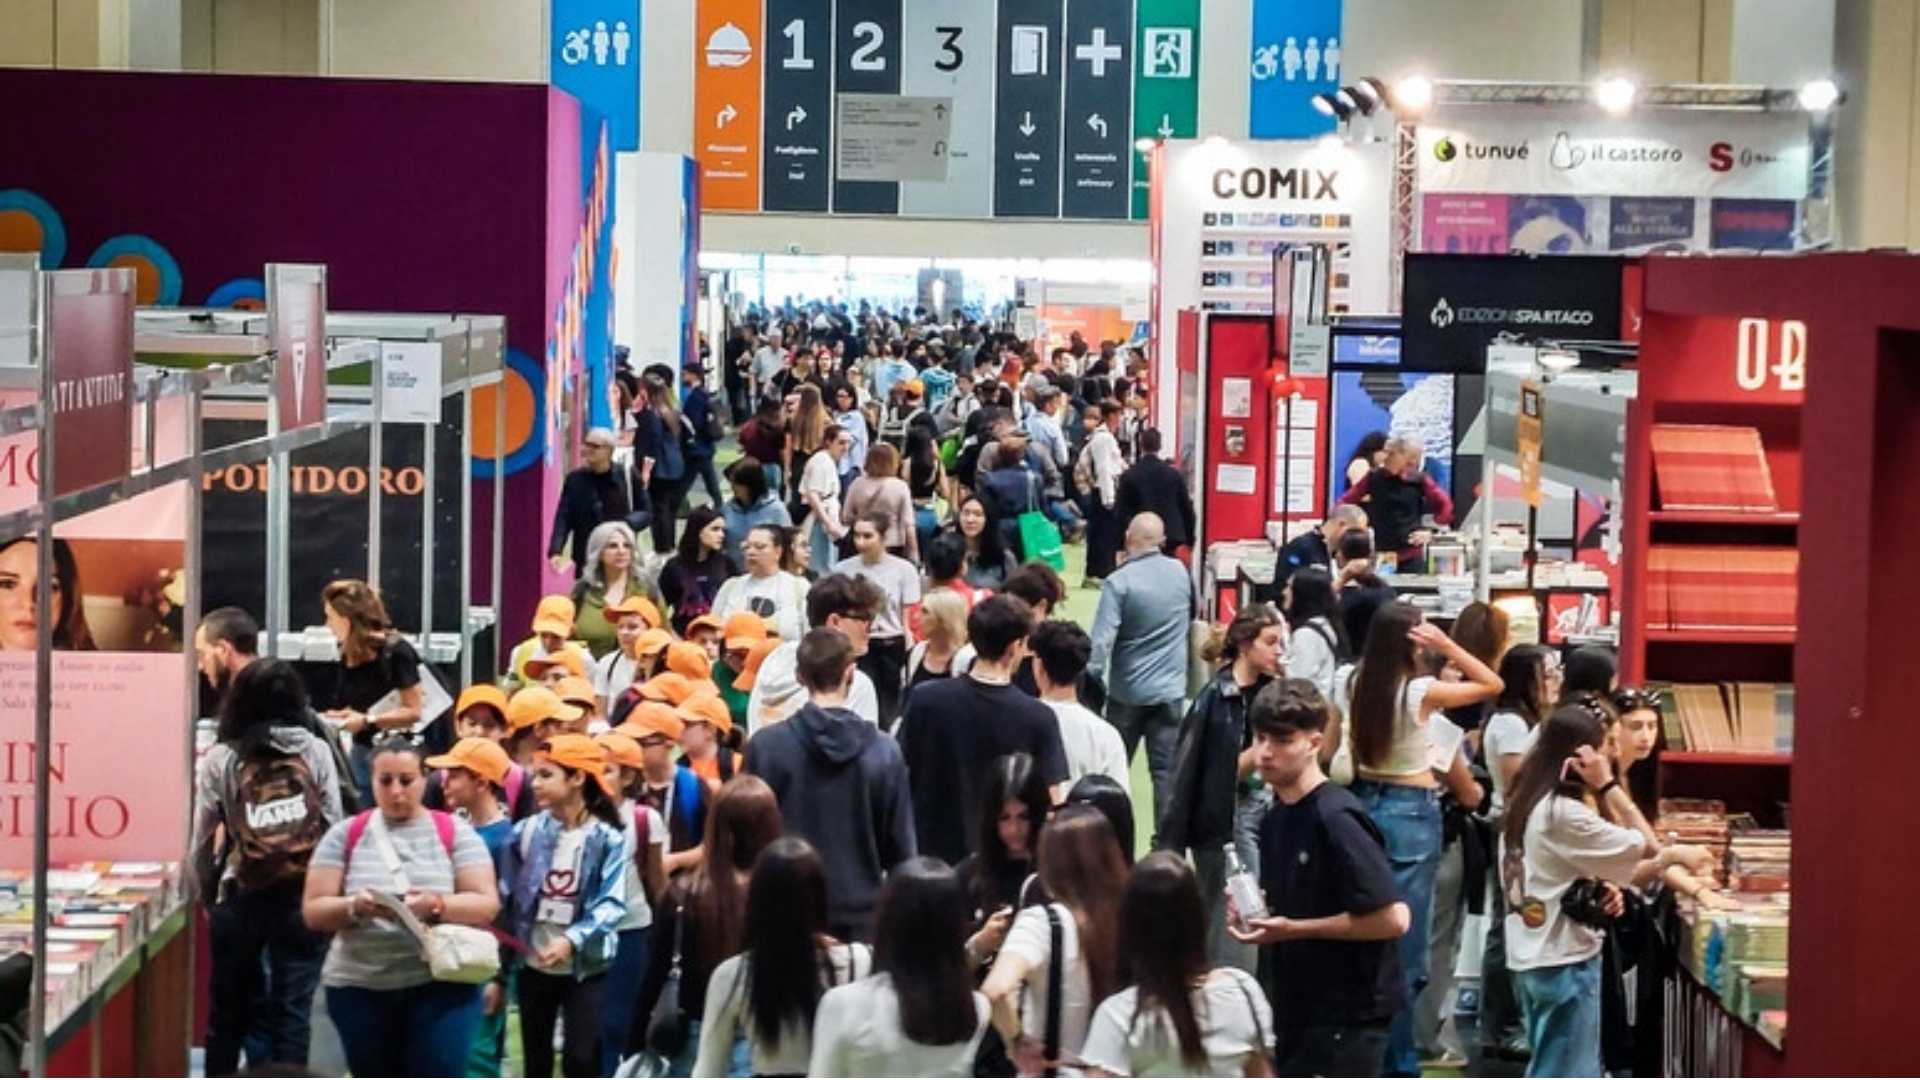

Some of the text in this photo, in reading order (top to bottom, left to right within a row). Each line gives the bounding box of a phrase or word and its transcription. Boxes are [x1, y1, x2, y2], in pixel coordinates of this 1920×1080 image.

[783, 19, 815, 69] 1
[850, 21, 886, 71] 2
[934, 26, 964, 71] 3
[1465, 140, 1529, 160] tunué
[1608, 147, 1683, 163] castoro
[1709, 142, 1734, 172] S
[1212, 167, 1338, 200] COMIX
